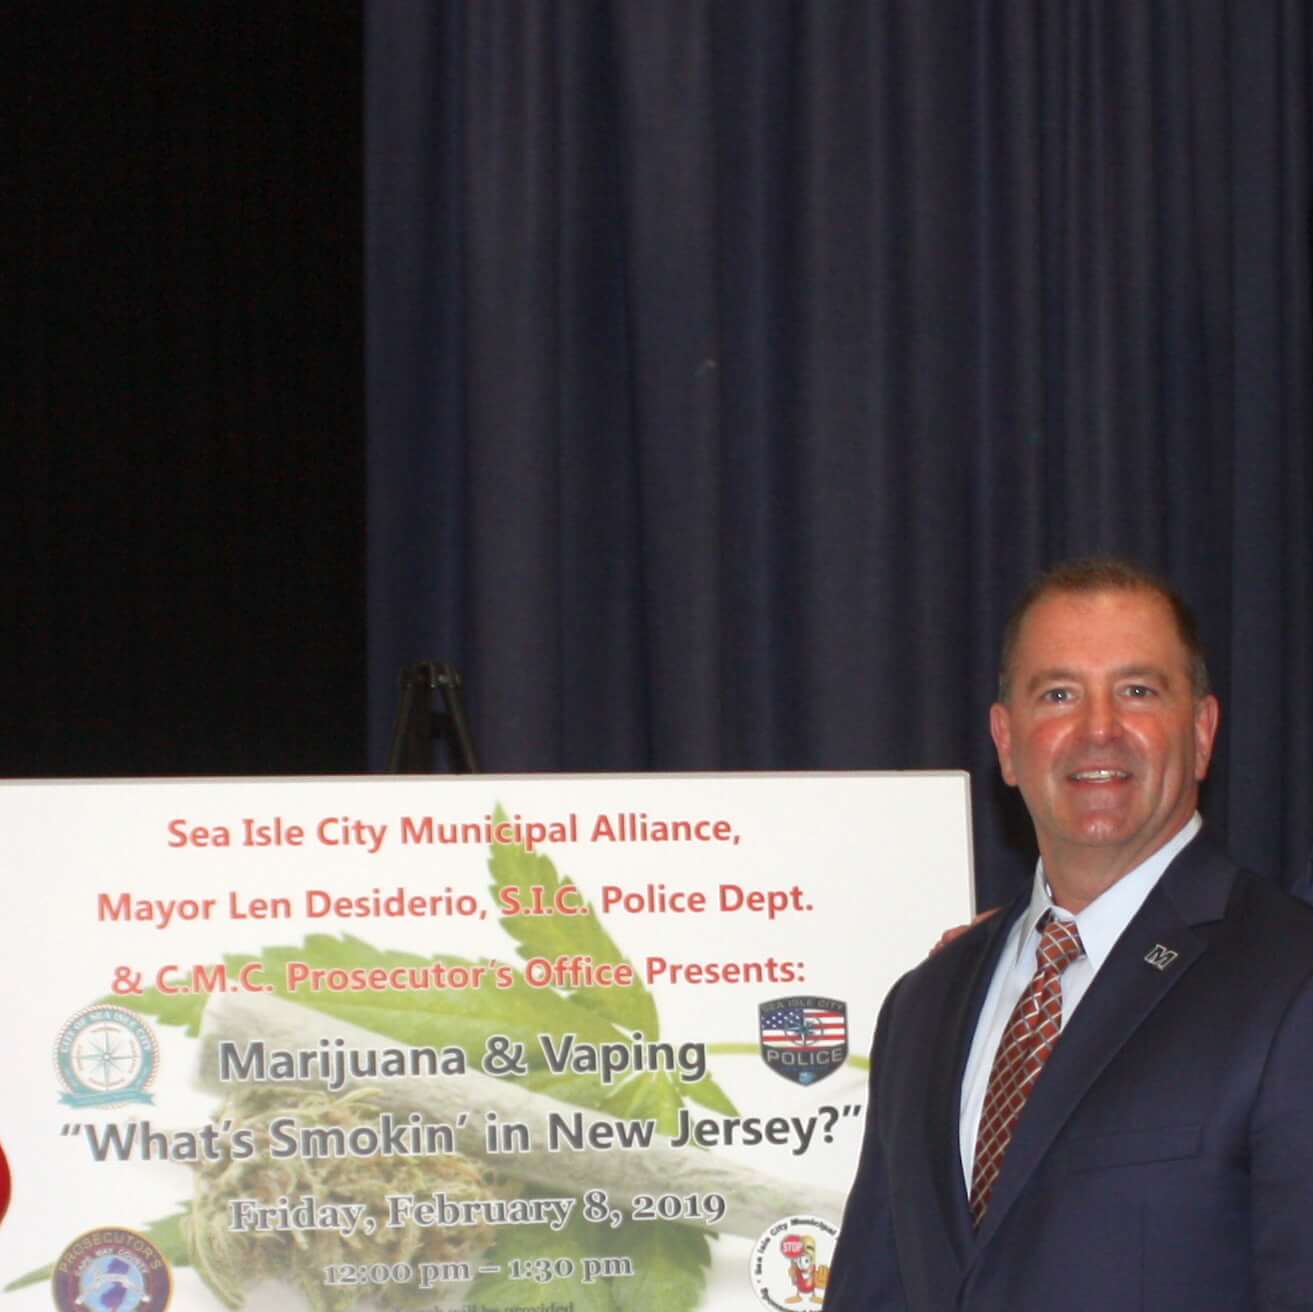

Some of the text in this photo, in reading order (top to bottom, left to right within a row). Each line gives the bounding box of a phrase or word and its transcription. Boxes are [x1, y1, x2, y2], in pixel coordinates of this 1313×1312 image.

[167, 812, 742, 854] Sea Isle City Municipal Alliance,
[97, 883, 814, 930] Mayor Len Desiderio, S.I.C. Police Dept.
[111, 956, 806, 995] & C.M.C. Prosecutor’s Office Presents:
[218, 1031, 707, 1090] Marijuana & Vaping
[767, 1047, 843, 1065] POLICE
[60, 1104, 862, 1162] “What’s Smokin’ in New Jersey?”
[231, 1190, 727, 1237] Friday, February 8, 2019
[770, 1222, 788, 1237] City
[790, 1217, 837, 1236] Municipal
[783, 1243, 803, 1252] STOP
[325, 1261, 413, 1287] 12:00
[418, 1260, 472, 1289] pm
[509, 1258, 574, 1284] 1:30
[581, 1255, 634, 1285] pm
